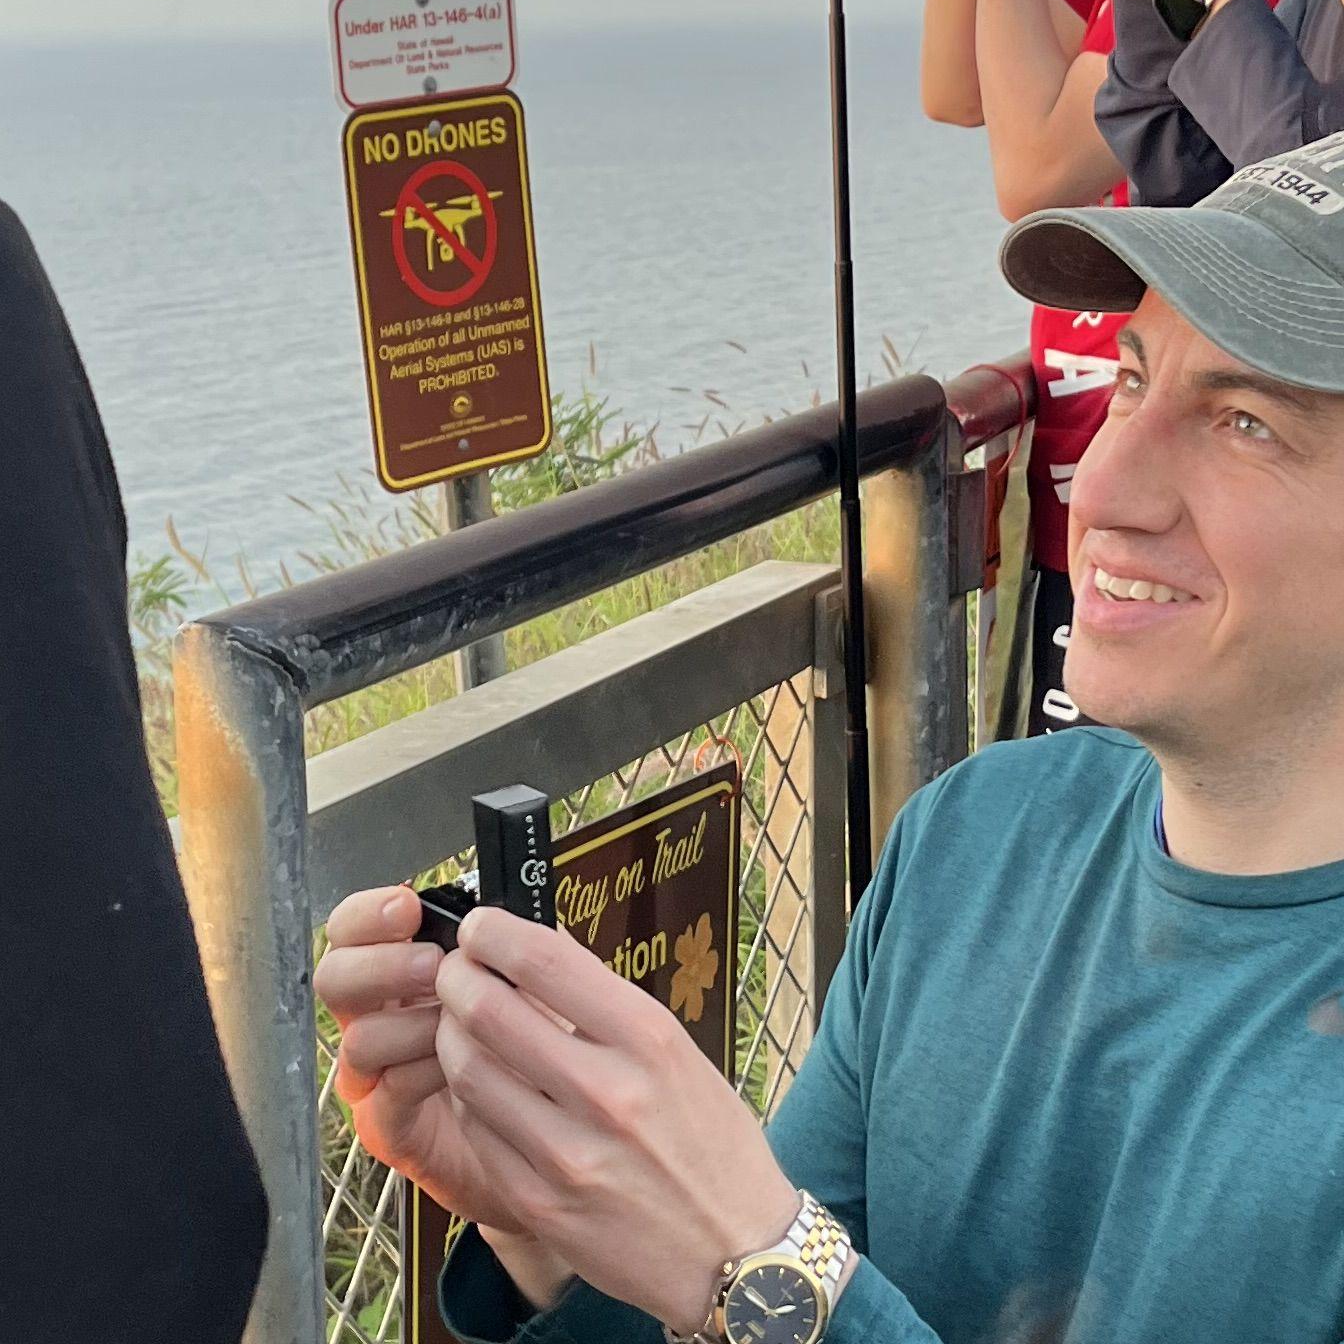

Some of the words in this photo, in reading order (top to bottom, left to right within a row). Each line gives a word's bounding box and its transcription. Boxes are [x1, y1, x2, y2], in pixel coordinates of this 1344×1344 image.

[345, 19, 385, 37] Under
[390, 14, 418, 31] HAR
[363, 132, 400, 165] NO
[406, 116, 506, 157] DRONES
[1270, 170, 1330, 205] 1944
[379, 336, 436, 362] Operation
[438, 331, 449, 347] of
[452, 328, 466, 344] all
[468, 315, 530, 340] Unmanned
[380, 325, 403, 338] HAR
[390, 359, 423, 379] Aerial
[425, 349, 475, 373] Systems
[477, 338, 511, 362] (UAS)
[514, 337, 525, 351] is
[418, 363, 500, 394] PROHIBITED.
[555, 874, 609, 946] Stay
[615, 858, 646, 902] on
[652, 810, 706, 885] Trail
